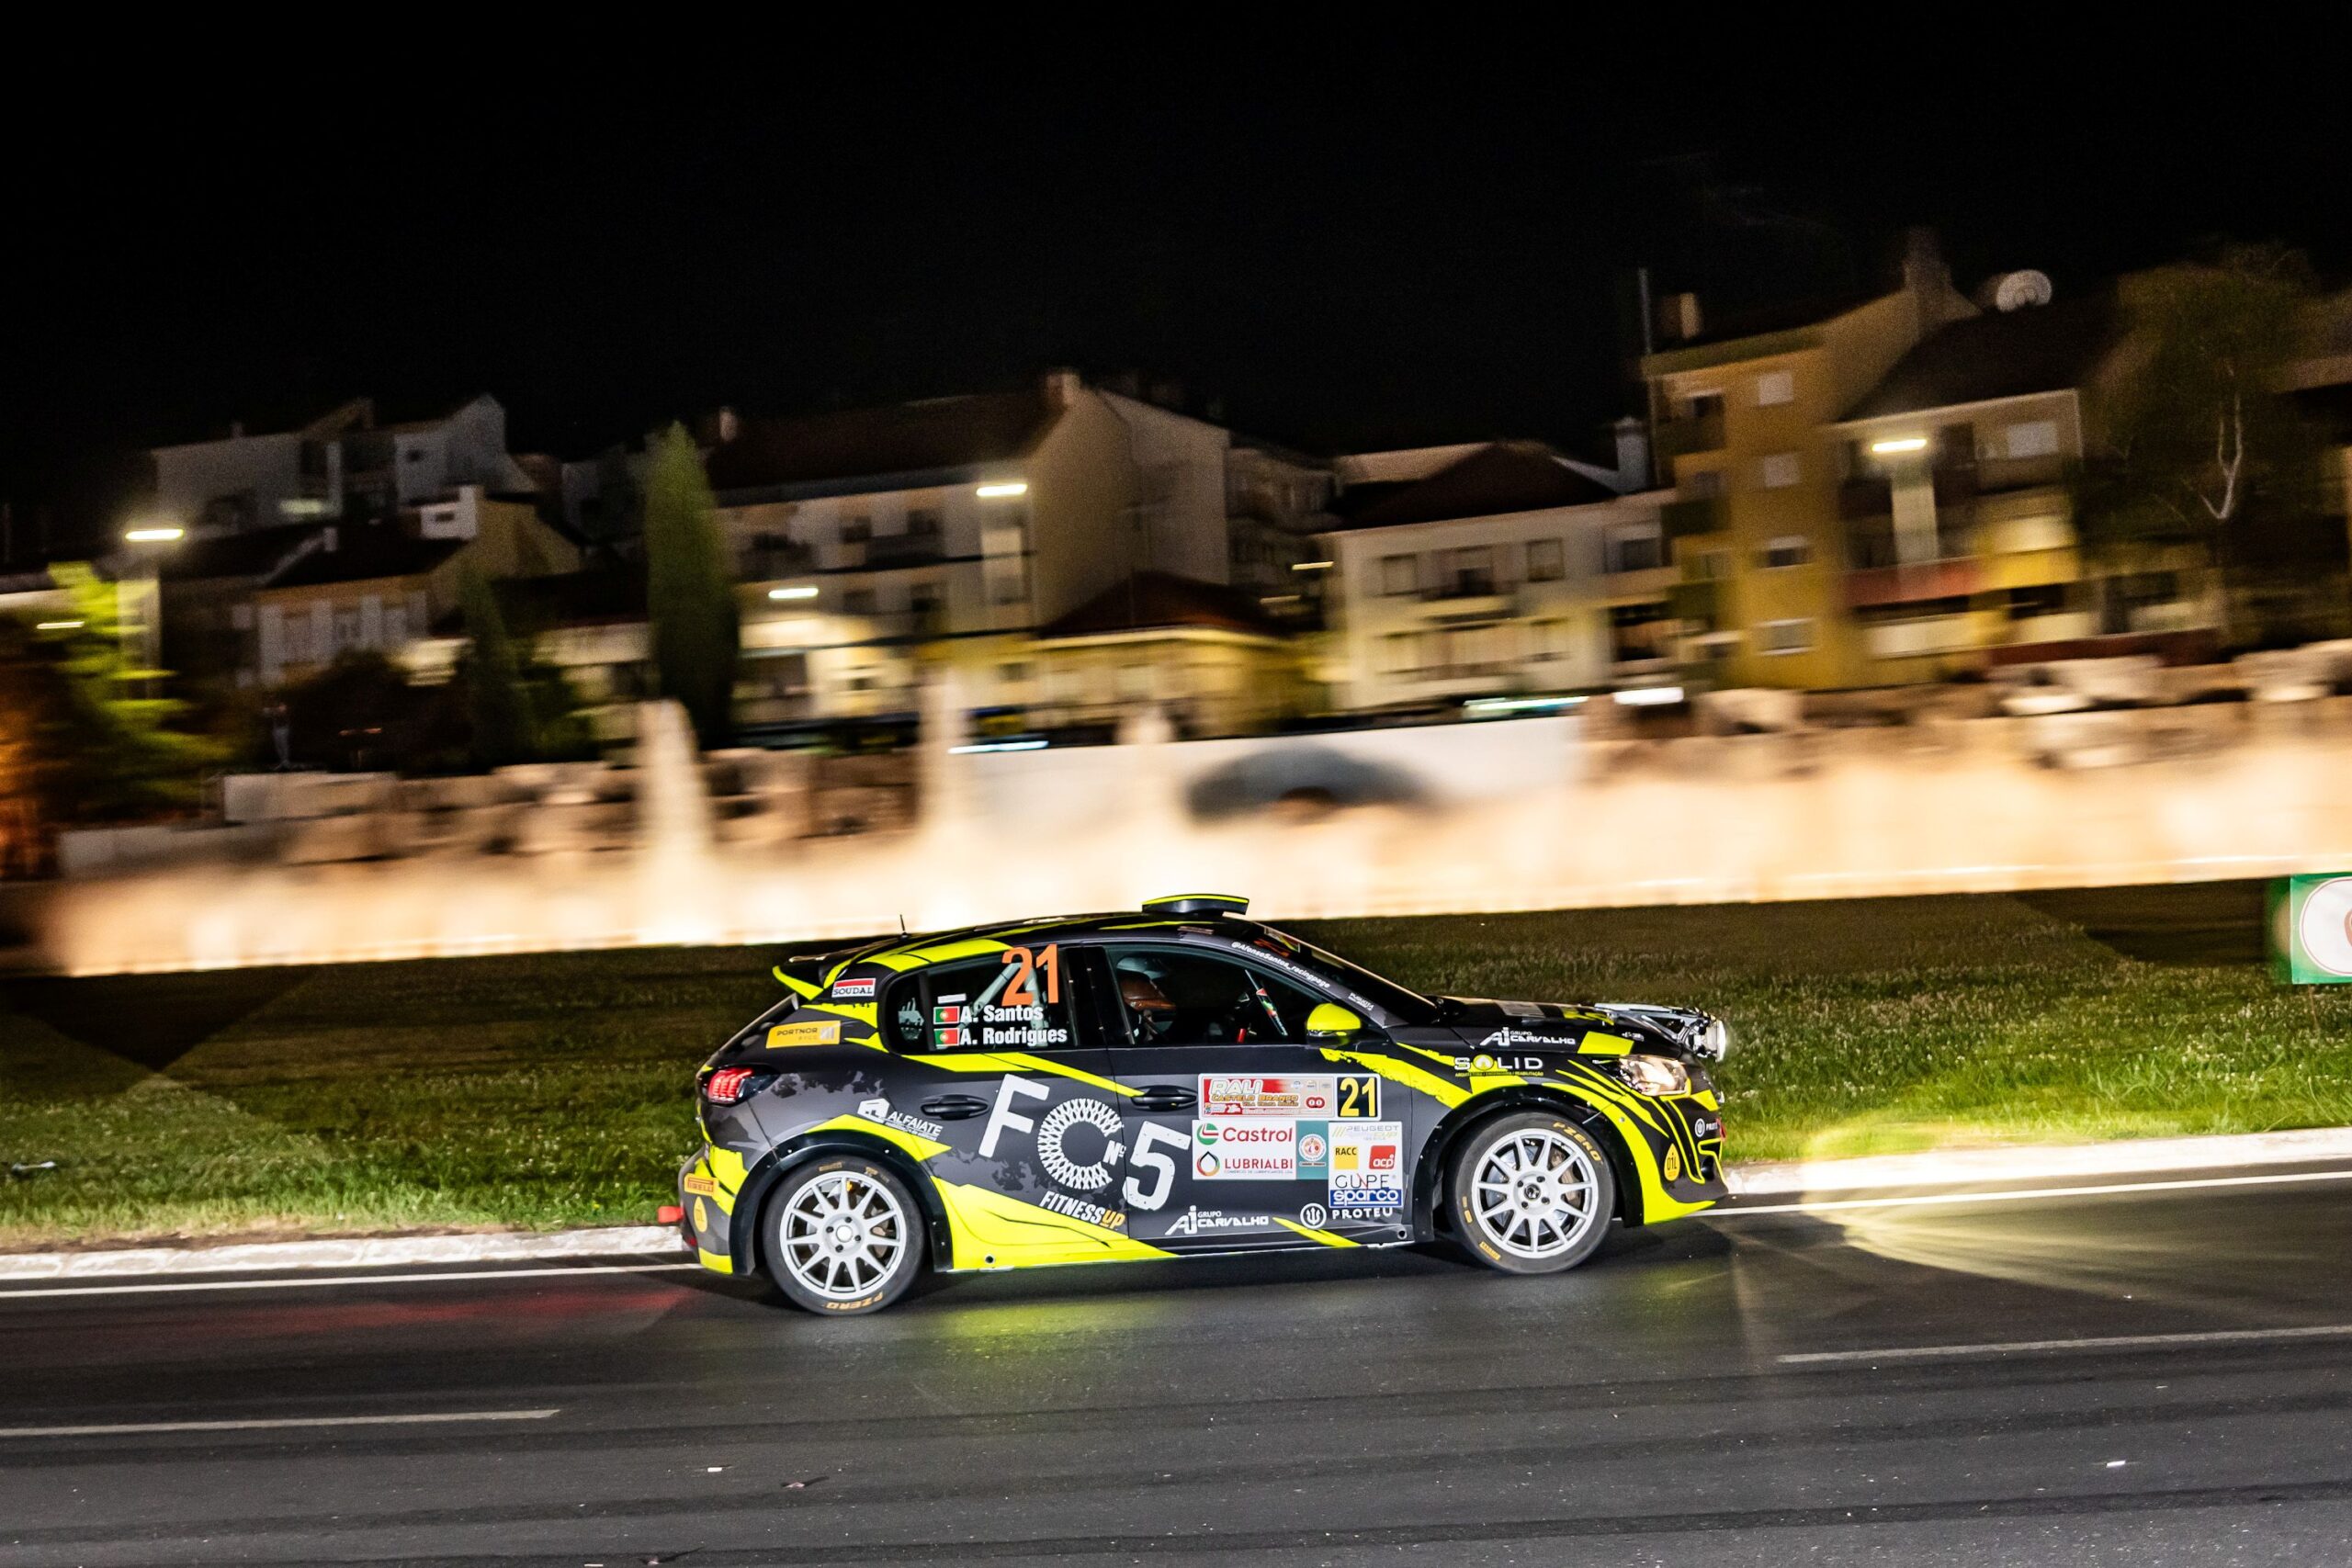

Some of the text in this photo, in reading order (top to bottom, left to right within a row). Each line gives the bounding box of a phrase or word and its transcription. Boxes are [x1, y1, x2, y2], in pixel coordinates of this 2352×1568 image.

[1001, 943, 1058, 1007] 21
[833, 986, 873, 996] SOUDAL
[959, 1004, 1044, 1022] A. Santos
[776, 1027, 818, 1037] PORTNOR
[959, 1026, 1068, 1047] A. Rodrigues
[1510, 1035, 1576, 1045] CARVALHO
[1210, 1078, 1262, 1095] RALI
[1212, 1094, 1256, 1102] CASTELO
[1340, 1077, 1376, 1117] 21
[888, 1111, 944, 1135] ALFAIATE
[1223, 1127, 1293, 1142] Castrol
[1335, 1147, 1357, 1156] RACC
[1225, 1158, 1293, 1169] LUBRIALBI
[1373, 1157, 1394, 1168] acp
[1333, 1190, 1398, 1206] sparco
[1332, 1207, 1394, 1220] PROTEU
[1197, 1216, 1269, 1227] CARVALHO
